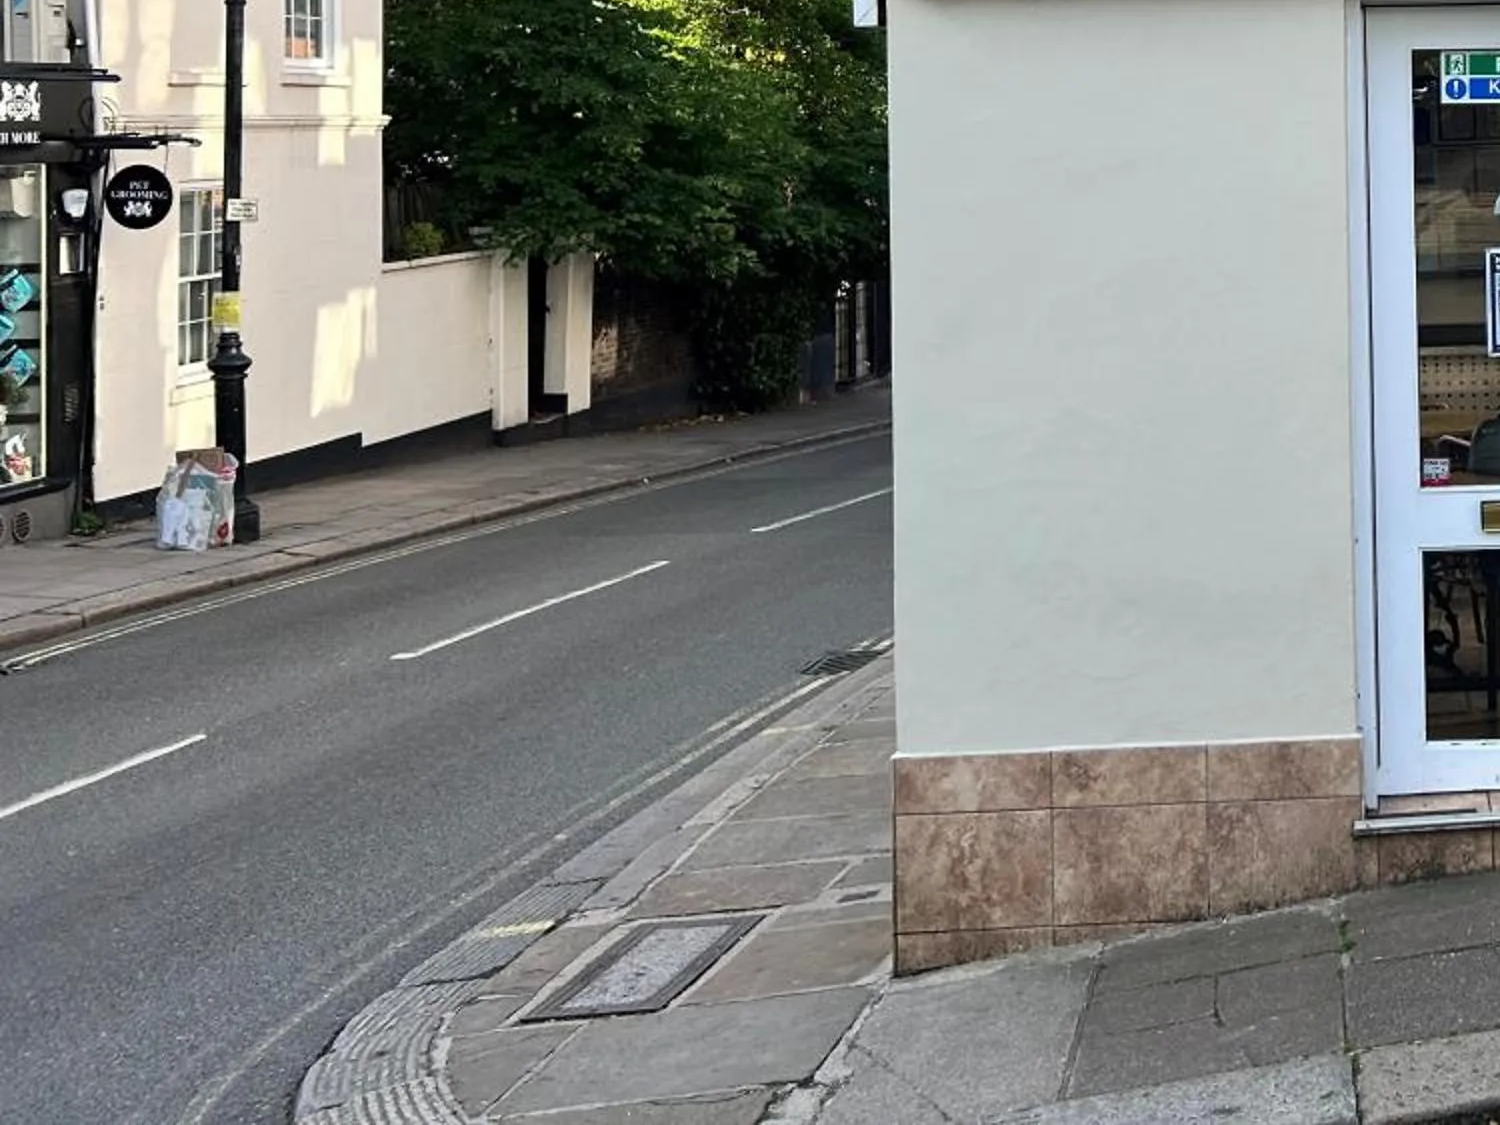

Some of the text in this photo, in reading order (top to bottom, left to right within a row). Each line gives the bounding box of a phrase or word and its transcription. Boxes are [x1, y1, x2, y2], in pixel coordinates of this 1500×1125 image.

[11, 131, 41, 145] MORE
[128, 180, 151, 190] PET
[110, 189, 169, 200] GROOMING
